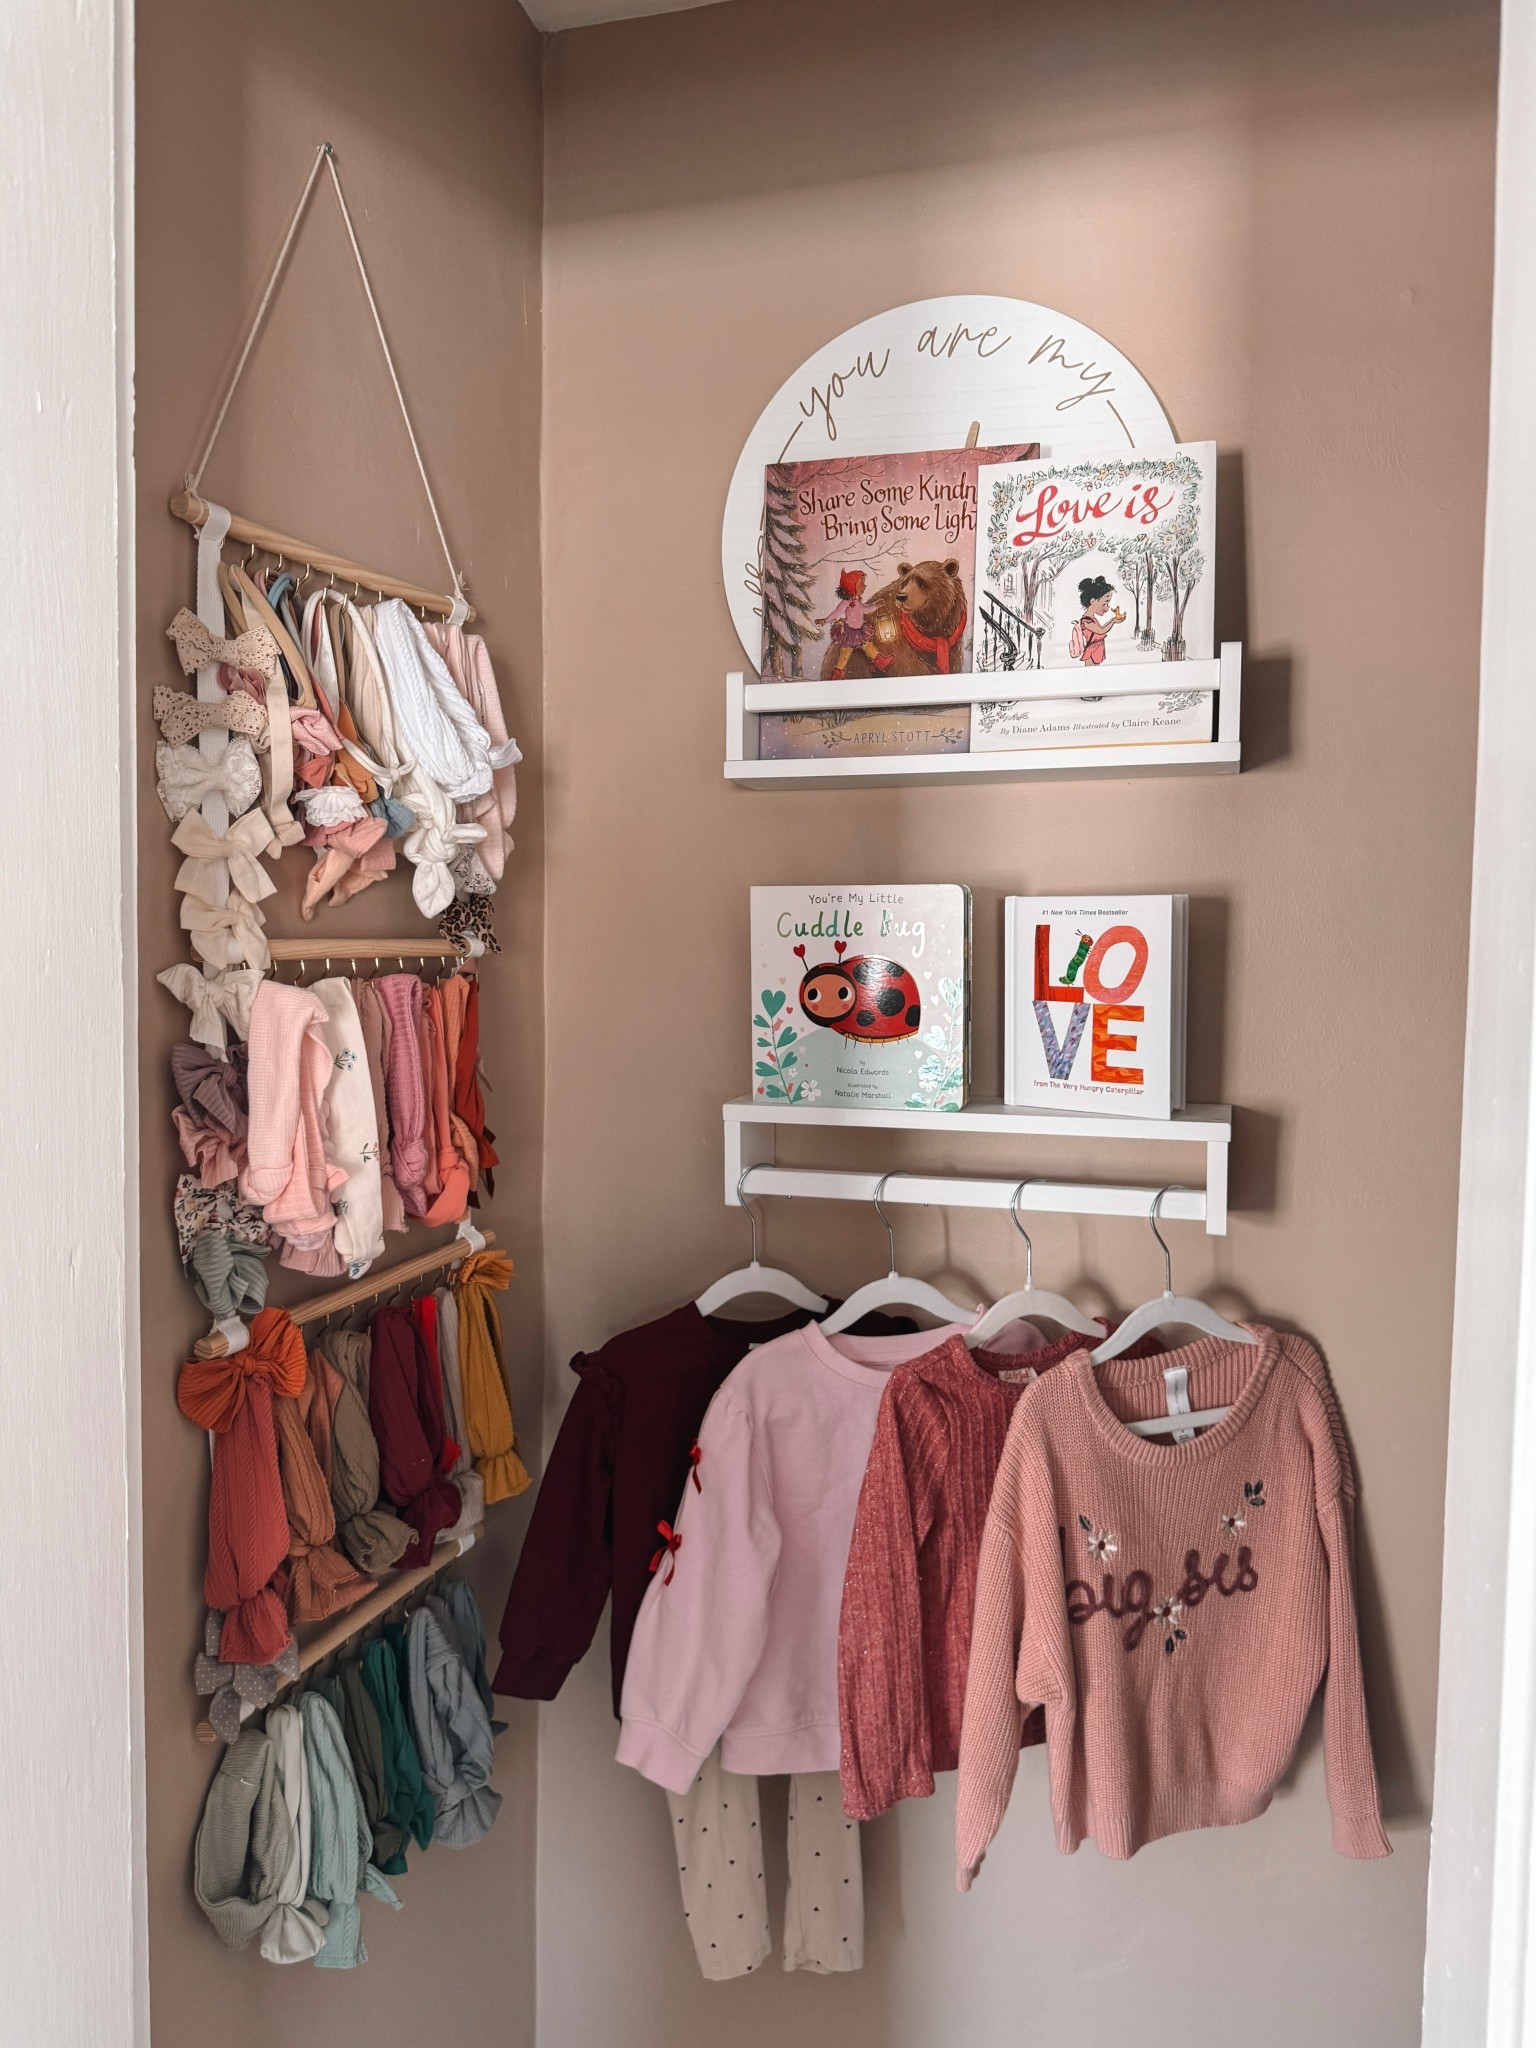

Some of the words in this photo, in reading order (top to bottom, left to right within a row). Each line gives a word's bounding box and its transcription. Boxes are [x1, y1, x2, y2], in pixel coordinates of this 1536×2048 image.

[800, 348, 890, 441] you
[917, 322, 1012, 358] are
[1028, 334, 1116, 411] my
[799, 487, 856, 515] Share
[860, 479, 914, 506] Some
[919, 471, 977, 505] Kindn
[820, 513, 878, 546] Bring
[881, 505, 930, 533] Some
[1012, 485, 1124, 548] Love
[1122, 483, 1176, 526] is
[853, 732, 887, 744] APRYL
[892, 730, 931, 742] STOTT
[1000, 727, 1010, 736] By
[1012, 725, 1038, 735] Diane
[1039, 723, 1070, 733] Adams
[1072, 721, 1110, 731] Illustrated
[1111, 721, 1120, 730] by
[1122, 719, 1149, 728] Claire
[1152, 717, 1182, 727] Keane
[808, 892, 843, 905] You're
[848, 892, 864, 906] My
[869, 893, 904, 905] Little
[777, 909, 864, 938] Cuddle
[880, 908, 926, 959] Bug
[836, 1066, 858, 1075] Nicola
[860, 1068, 890, 1076] Edwards
[834, 1089, 860, 1098] Natalie
[861, 1091, 892, 1099] Marshall
[1033, 1080, 1048, 1088] from
[1049, 1081, 1060, 1089] The
[1062, 1082, 1078, 1092] Very
[1079, 1084, 1104, 1094] Hungry
[1105, 1086, 1144, 1096] Caterpillar
[1176, 1546, 1259, 1607] sis
